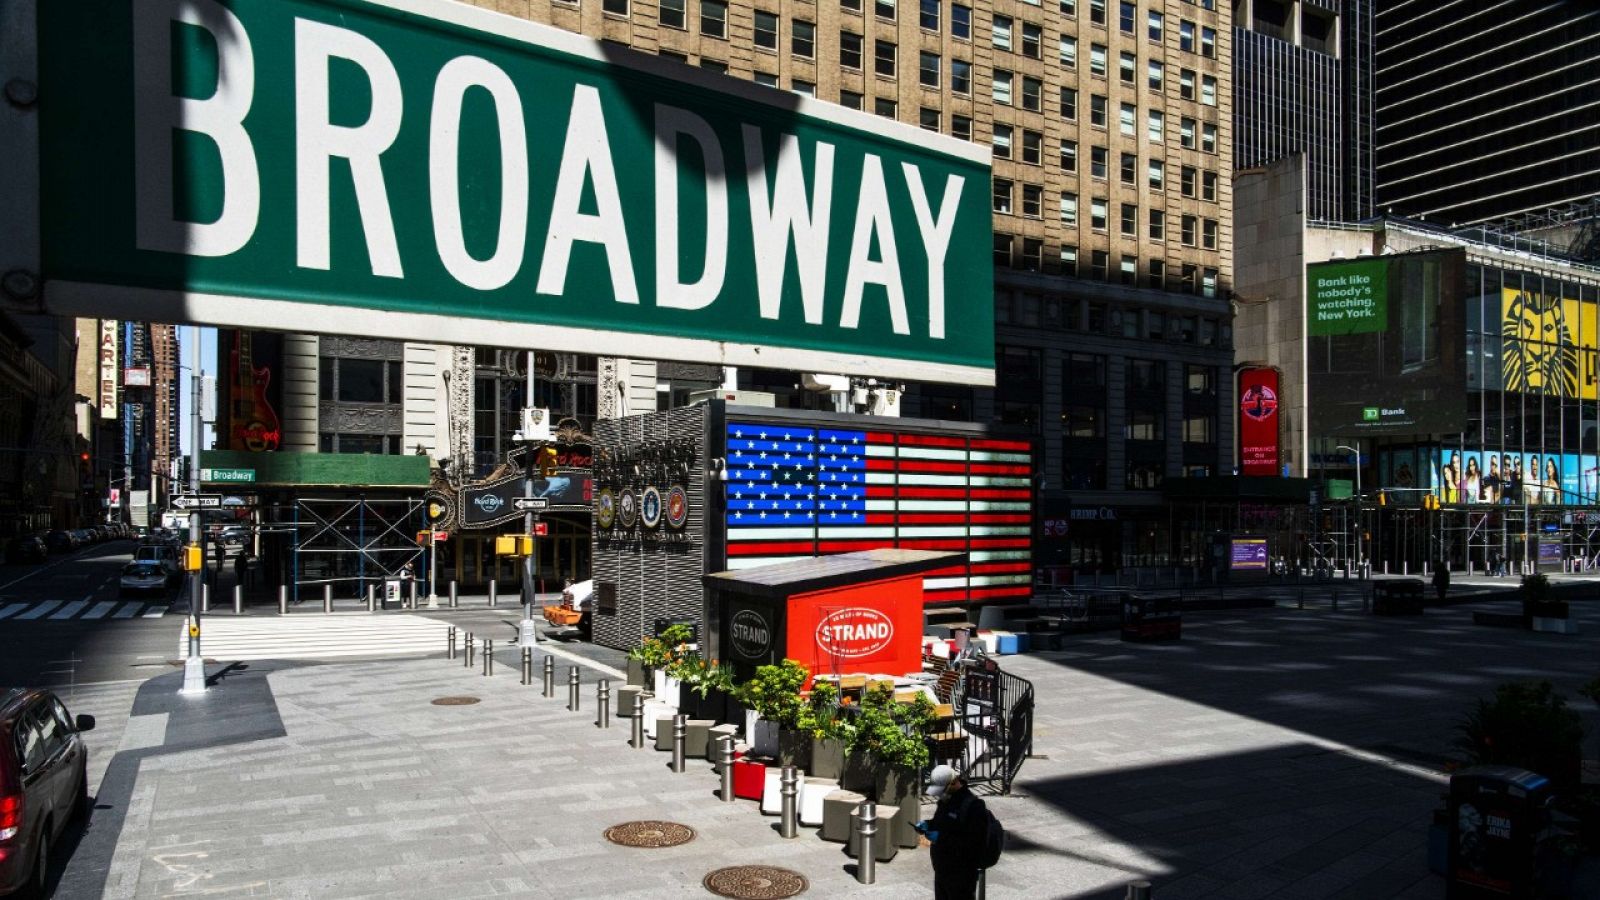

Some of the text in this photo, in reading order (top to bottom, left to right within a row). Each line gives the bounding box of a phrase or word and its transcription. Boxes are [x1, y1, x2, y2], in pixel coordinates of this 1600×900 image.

[134, 0, 965, 340] BROADWAY
[1317, 275, 1371, 288] Bank like
[1317, 286, 1372, 299] nobody's
[1317, 297, 1376, 310] watching,
[1317, 308, 1376, 321] New York.
[1380, 408, 1406, 416] Bank
[213, 469, 252, 482] Broadway
[733, 622, 767, 646] STRAND
[821, 622, 889, 642] STRAND
